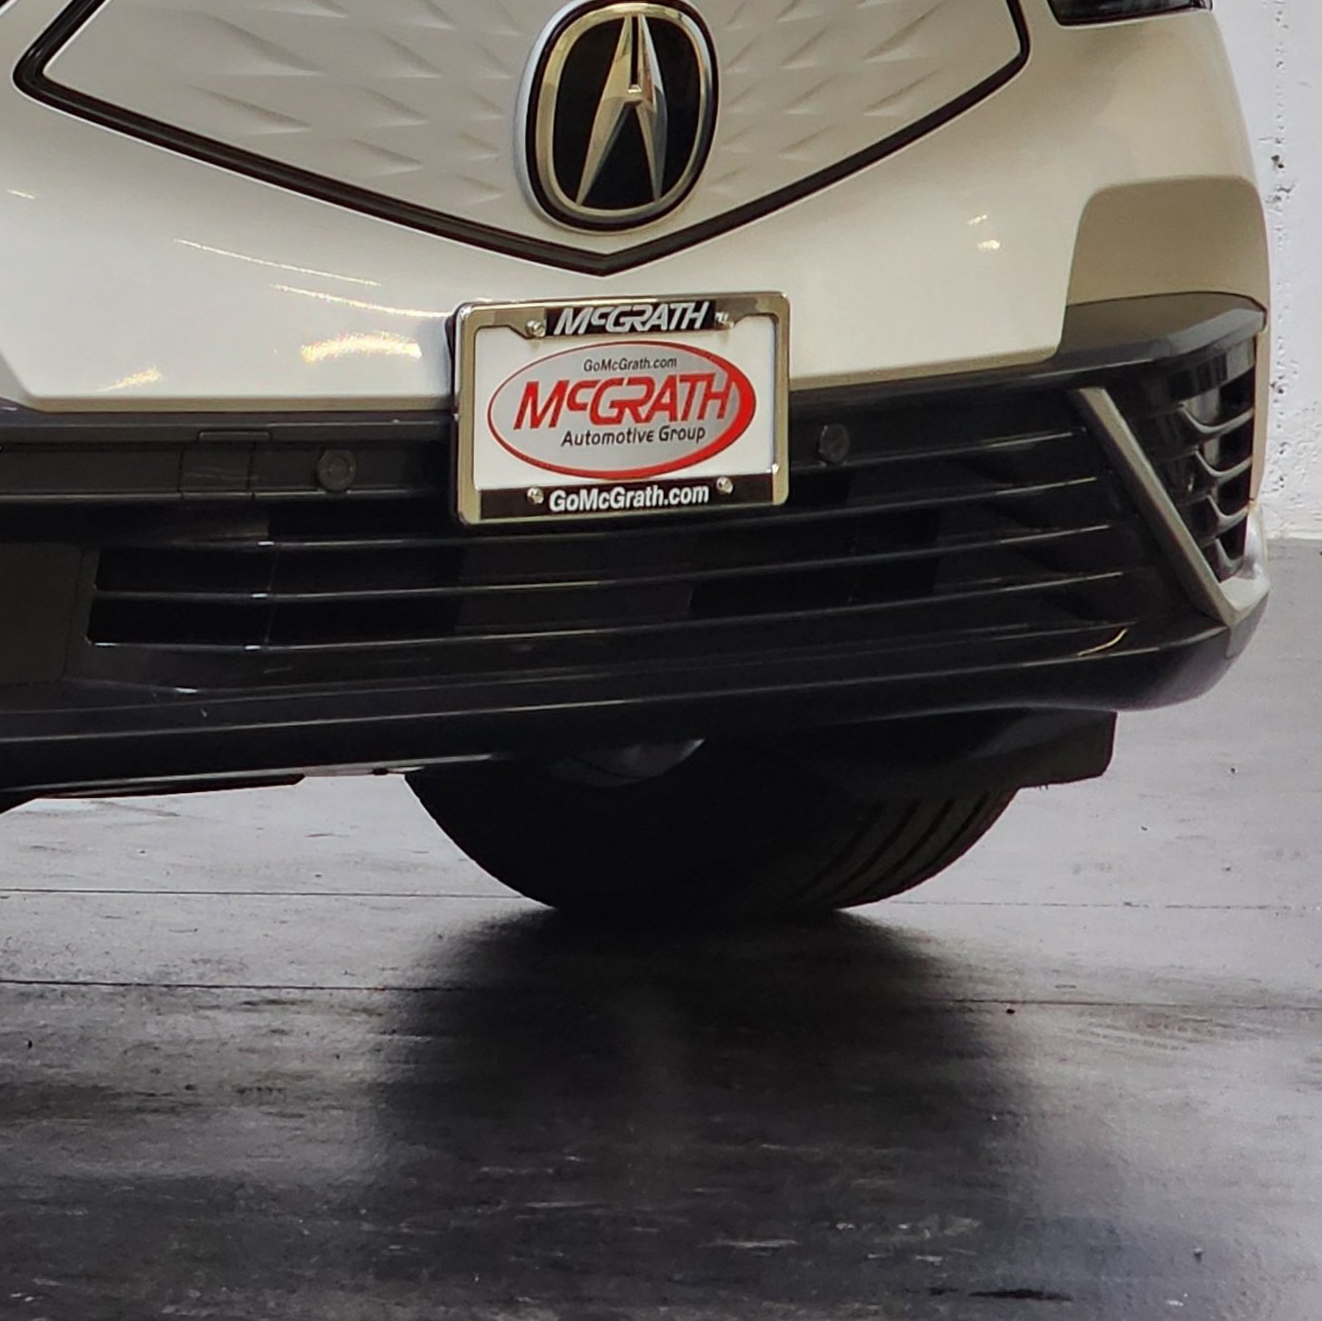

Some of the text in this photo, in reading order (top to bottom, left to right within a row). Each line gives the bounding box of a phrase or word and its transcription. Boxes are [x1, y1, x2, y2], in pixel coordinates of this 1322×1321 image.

[583, 356, 677, 373] GoMcGrath.com
[560, 425, 706, 448] Automotive Group
[548, 483, 710, 513] GoMcGrath.com
